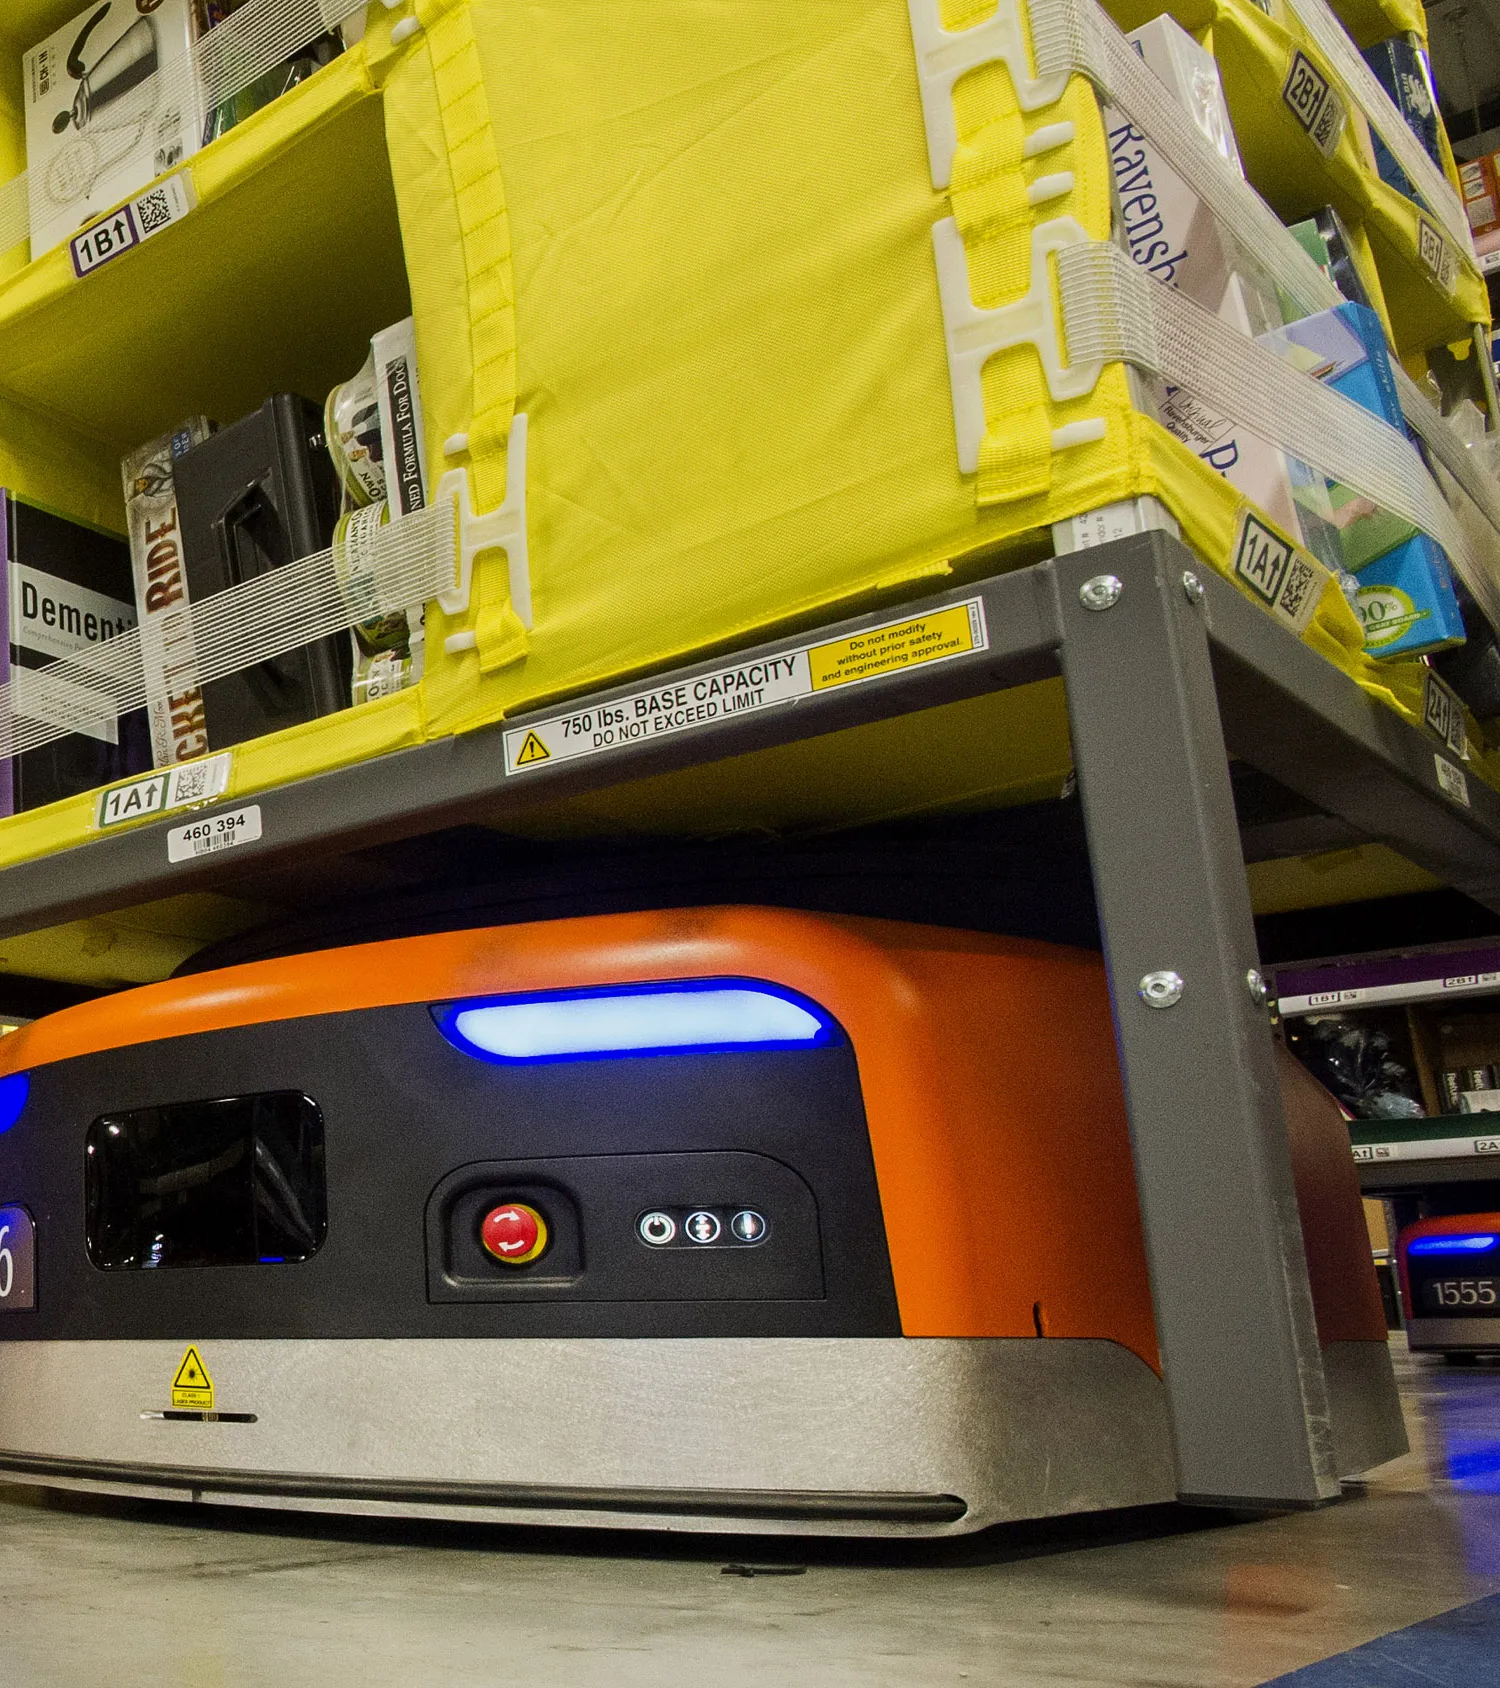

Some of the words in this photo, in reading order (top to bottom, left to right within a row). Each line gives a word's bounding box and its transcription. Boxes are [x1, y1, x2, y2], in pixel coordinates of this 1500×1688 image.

[1295, 67, 1316, 111] 2B
[80, 229, 114, 266] 1B
[393, 366, 408, 396] DOG
[397, 399, 411, 422] FOR
[1164, 406, 1210, 444] Ravensburger
[1166, 422, 1192, 443] Quality
[402, 422, 418, 483] FORMULA
[145, 507, 184, 615] RIDE
[1246, 534, 1272, 585] 1A
[837, 648, 877, 666] without
[880, 640, 906, 656] prior
[908, 631, 943, 647] safety
[850, 641, 865, 650] Do
[868, 634, 885, 645] not
[888, 623, 926, 640] modify
[821, 670, 842, 682] and
[844, 651, 909, 675] engineering
[562, 714, 592, 737] 750
[598, 708, 629, 728] lbs.
[634, 687, 688, 718] BASE
[693, 656, 796, 701] CAPACITY
[593, 732, 614, 748] DO
[619, 720, 650, 741] NOT
[654, 702, 718, 731] EXCEED
[722, 688, 765, 713] LIMIT
[109, 788, 142, 816] 1A
[183, 824, 211, 841] 460
[217, 814, 246, 832] 394
[1433, 1281, 1496, 1306] 1555
